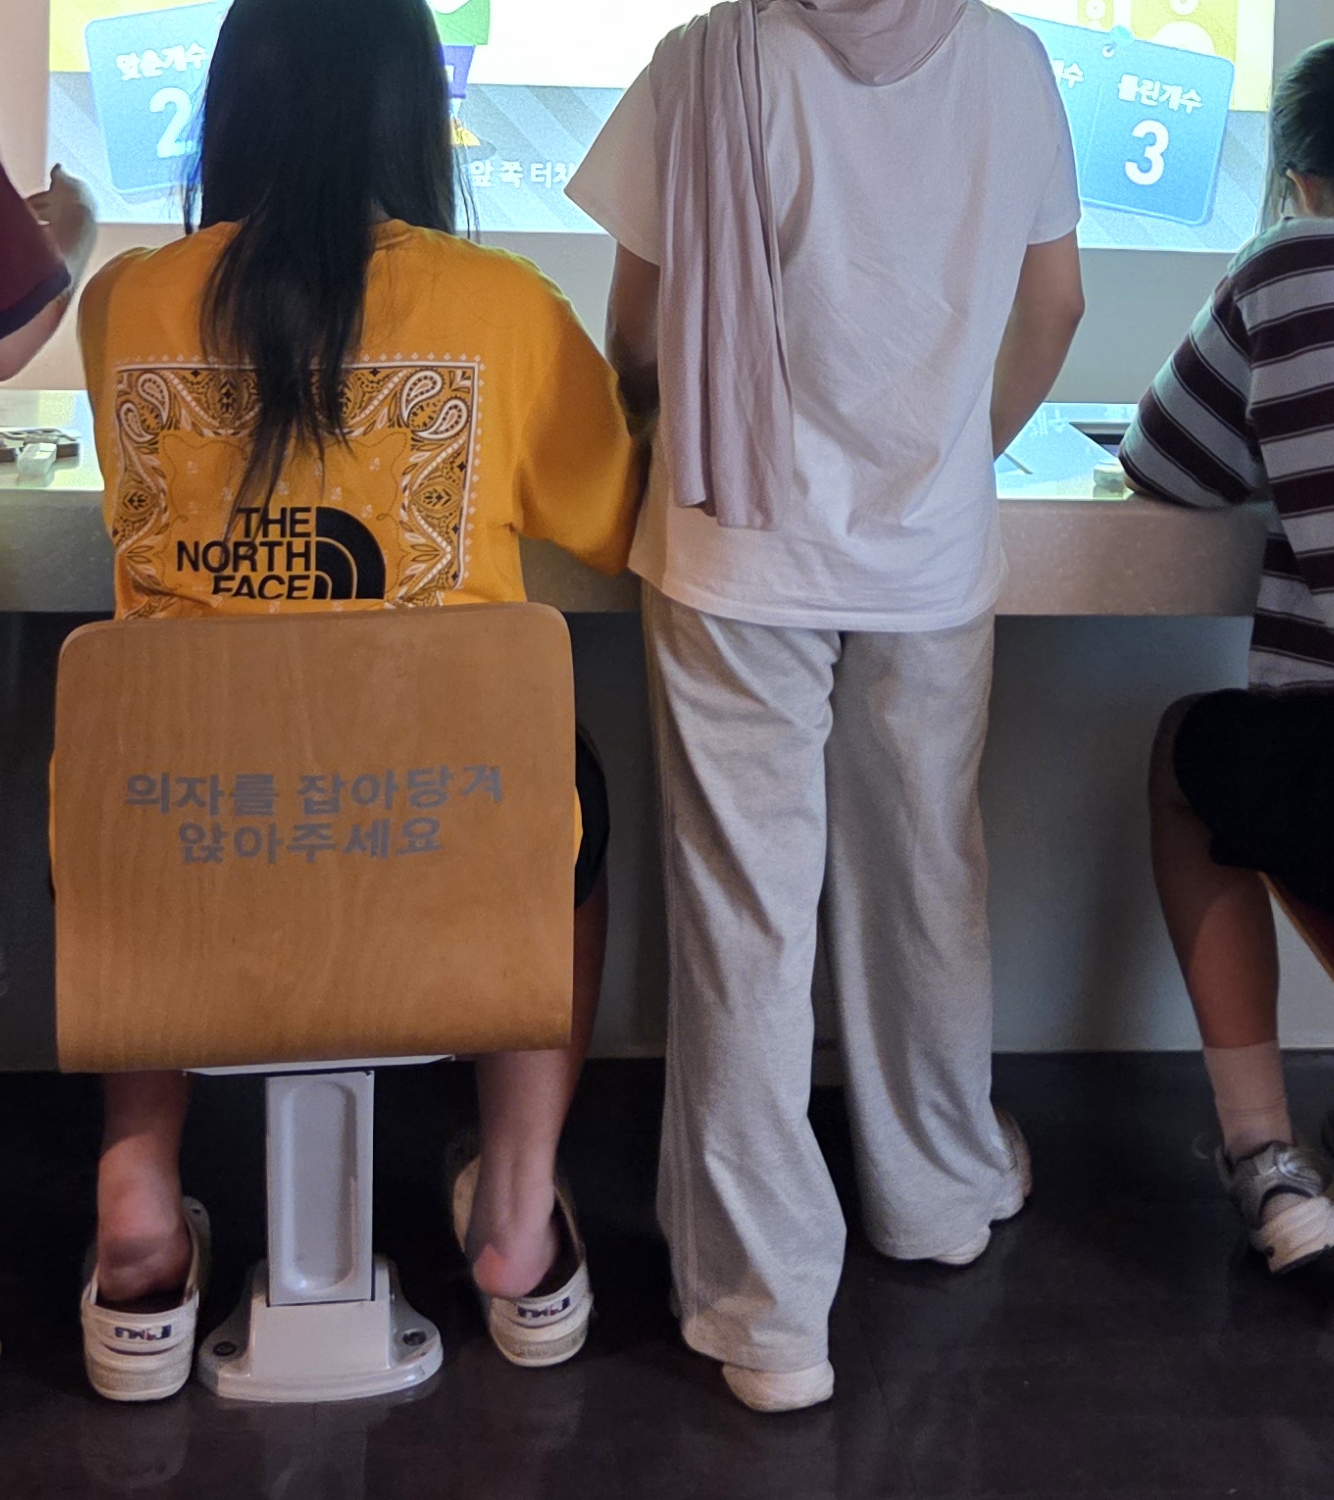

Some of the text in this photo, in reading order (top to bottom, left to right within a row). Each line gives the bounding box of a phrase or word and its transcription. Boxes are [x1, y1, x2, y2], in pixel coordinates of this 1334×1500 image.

[1117, 73, 1204, 115] 틀린개수
[149, 86, 198, 160] 2
[1124, 119, 1170, 187] 3
[235, 506, 313, 539] THE
[175, 539, 312, 574] NORTH
[211, 573, 312, 601] FACE
[125, 764, 503, 817] 의자를 잡아당겨
[178, 816, 443, 865] 앉아주세요
